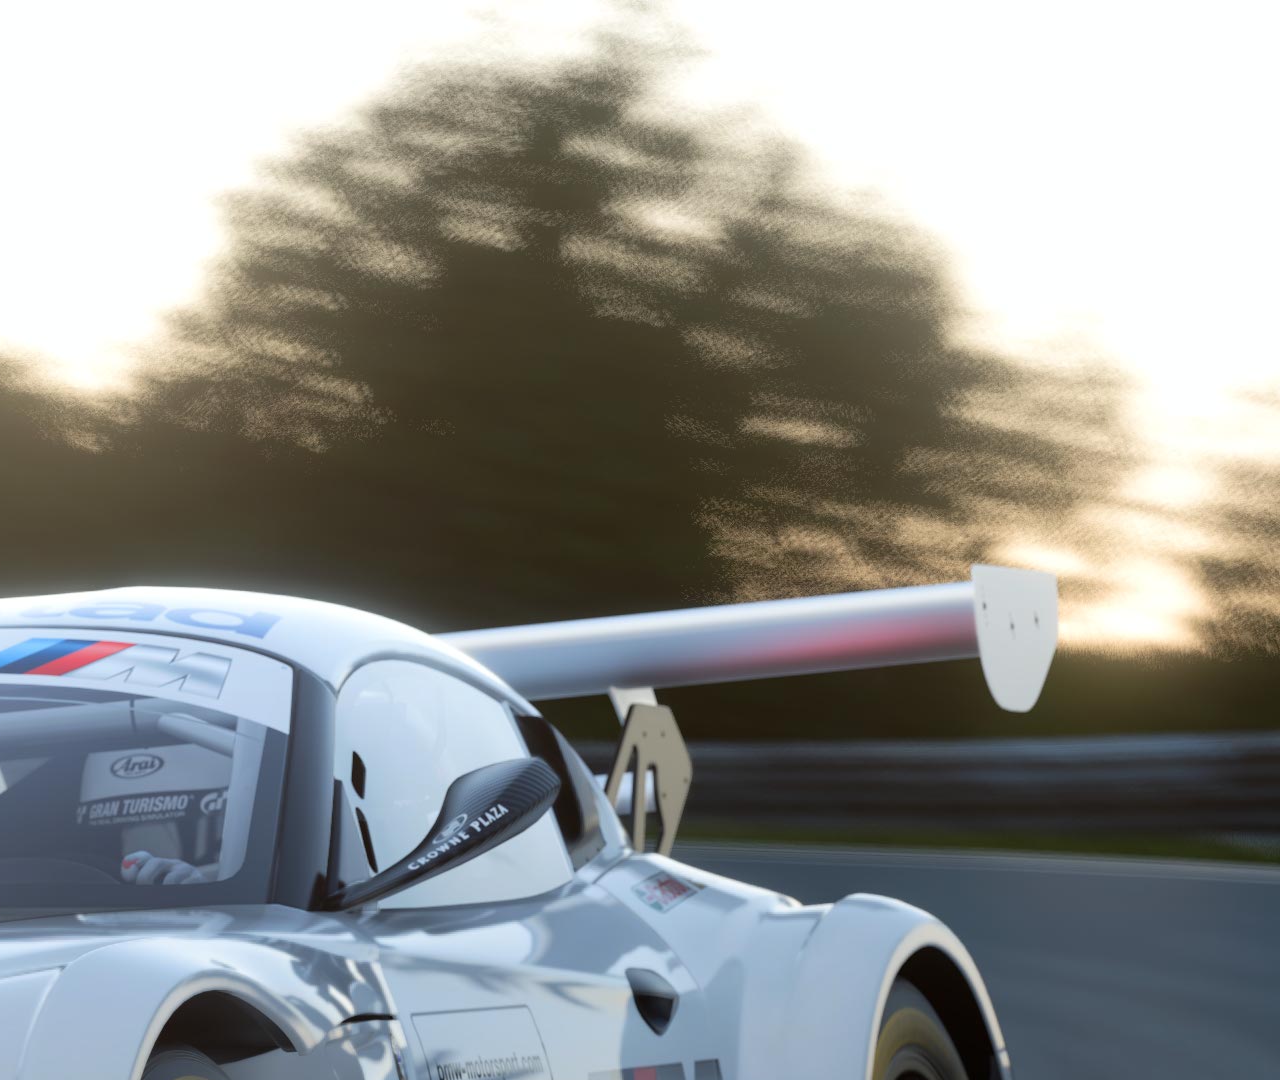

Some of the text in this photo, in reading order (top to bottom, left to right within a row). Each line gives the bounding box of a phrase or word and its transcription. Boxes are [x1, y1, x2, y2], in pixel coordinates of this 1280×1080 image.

[115, 756, 156, 774] Arai
[90, 800, 120, 819] GRAN
[122, 794, 189, 814] TURISMO
[407, 803, 510, 871] CROWNE PLAZA
